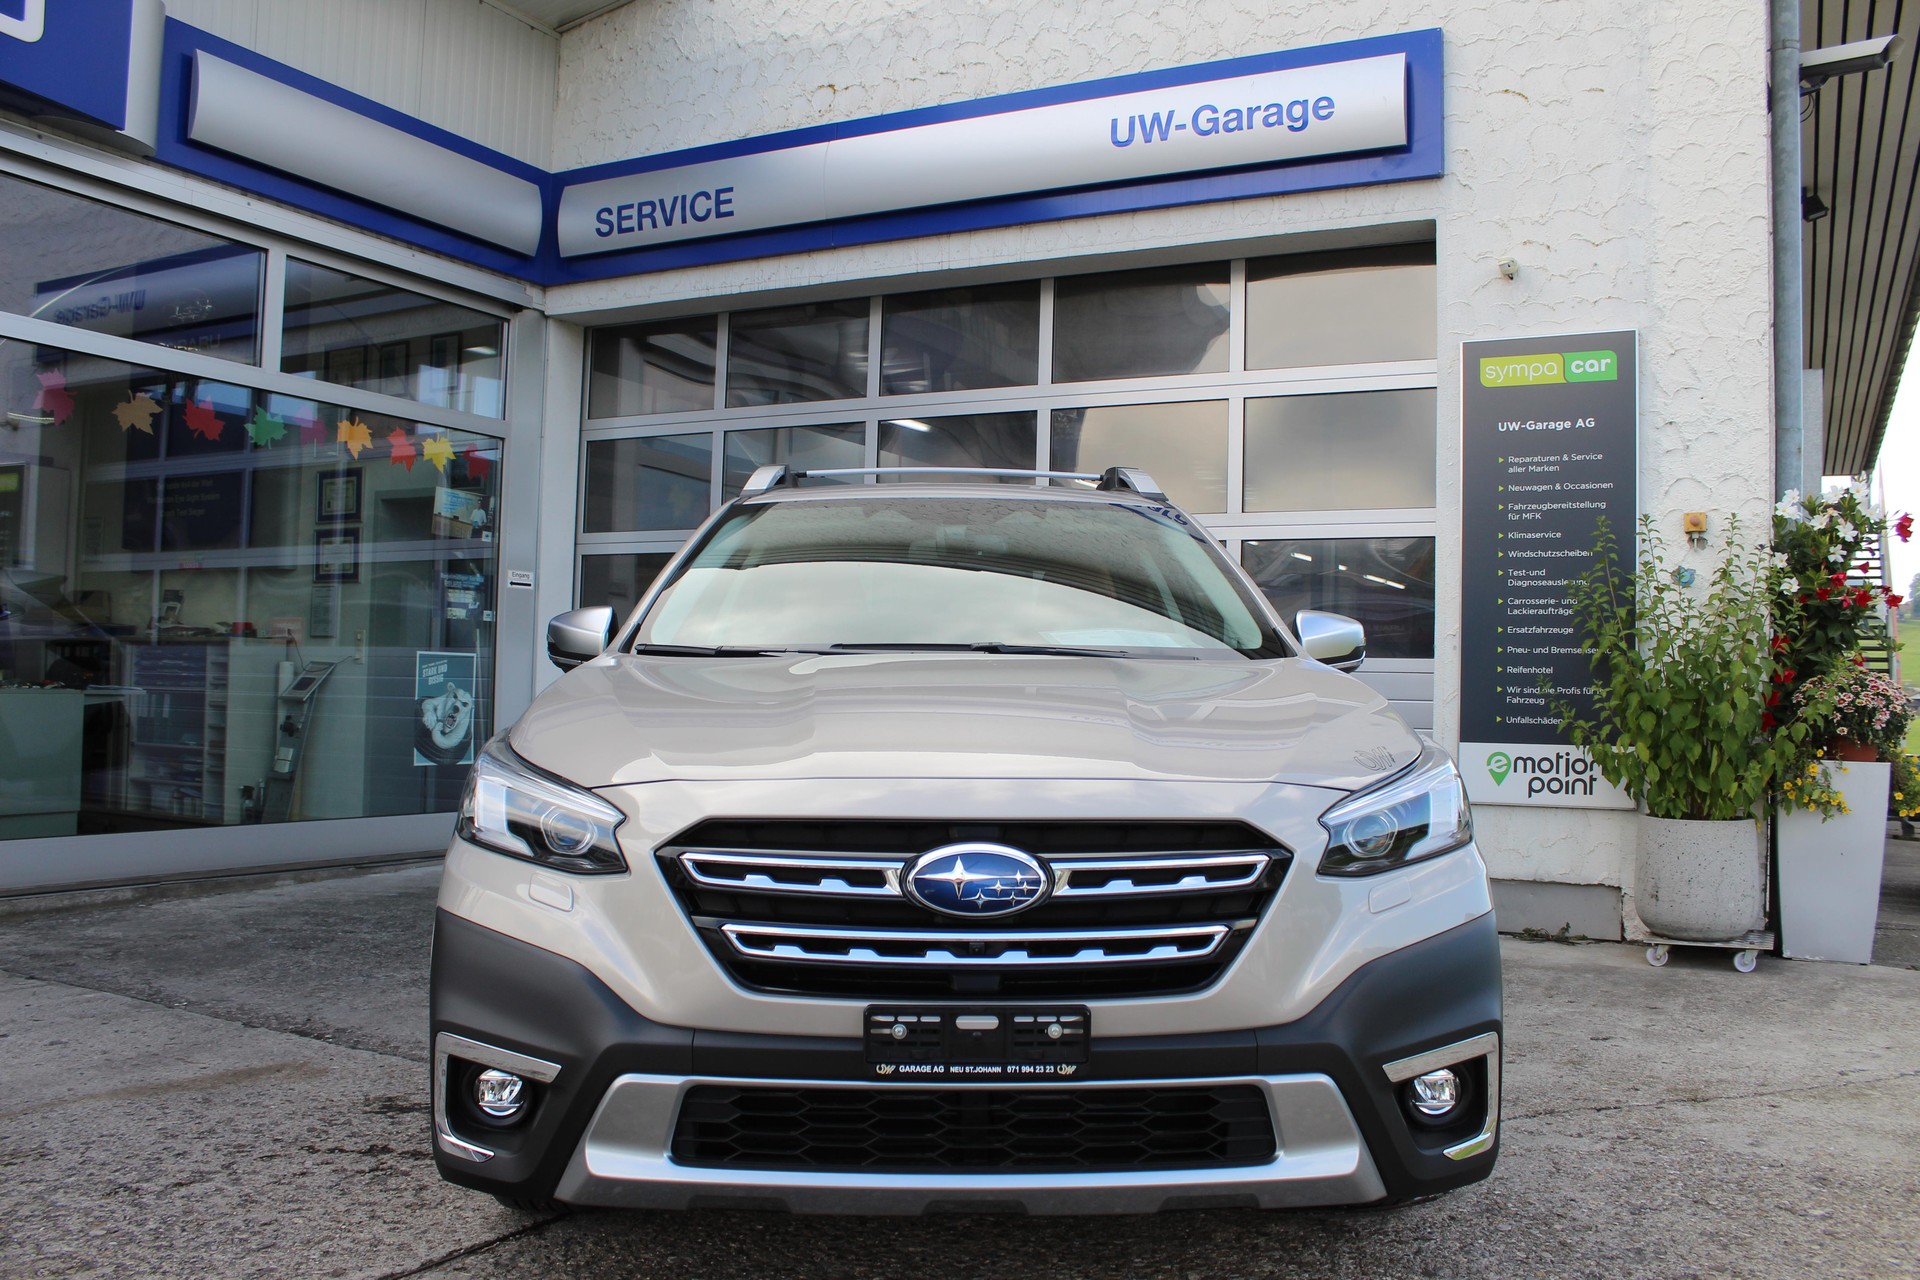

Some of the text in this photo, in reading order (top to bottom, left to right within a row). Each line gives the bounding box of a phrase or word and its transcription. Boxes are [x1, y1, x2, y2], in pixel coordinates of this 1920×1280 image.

[1111, 90, 1336, 148] UW-Garage
[595, 187, 734, 238] SERVICE
[1485, 357, 1610, 383] sympa car
[1498, 417, 1596, 432] UW-Garage AG
[1508, 452, 1603, 465] Reparaturen & Service
[1508, 464, 1560, 474] aller Marken
[1508, 481, 1613, 494] Neuwagen & Occasionen
[1508, 500, 1607, 513] Fahrzeugbereitstellung
[1508, 511, 1542, 521] für MFK
[1508, 530, 1562, 540] Klimaservice
[511, 572, 530, 580] Eingang
[1508, 568, 1546, 577] Test-und
[1508, 597, 1559, 606] Carrosserie-
[1507, 625, 1574, 636] Ersatzfahrzeuge
[1507, 645, 1531, 654] Pneu-
[1532, 645, 1549, 654] und
[1507, 666, 1553, 675] Reifenhotel
[1506, 686, 1522, 694] Wir
[1523, 686, 1540, 694] sind
[1557, 686, 1581, 695] Profis
[1506, 696, 1545, 706] Fahrzeug
[1528, 775, 1597, 799] point
[899, 1065, 932, 1073] GARAGE
[932, 1065, 945, 1073] AG
[1007, 1065, 1020, 1073] 071
[1021, 1065, 1034, 1073] 994
[1035, 1065, 1045, 1073] 23
[1045, 1065, 1054, 1073] 23
